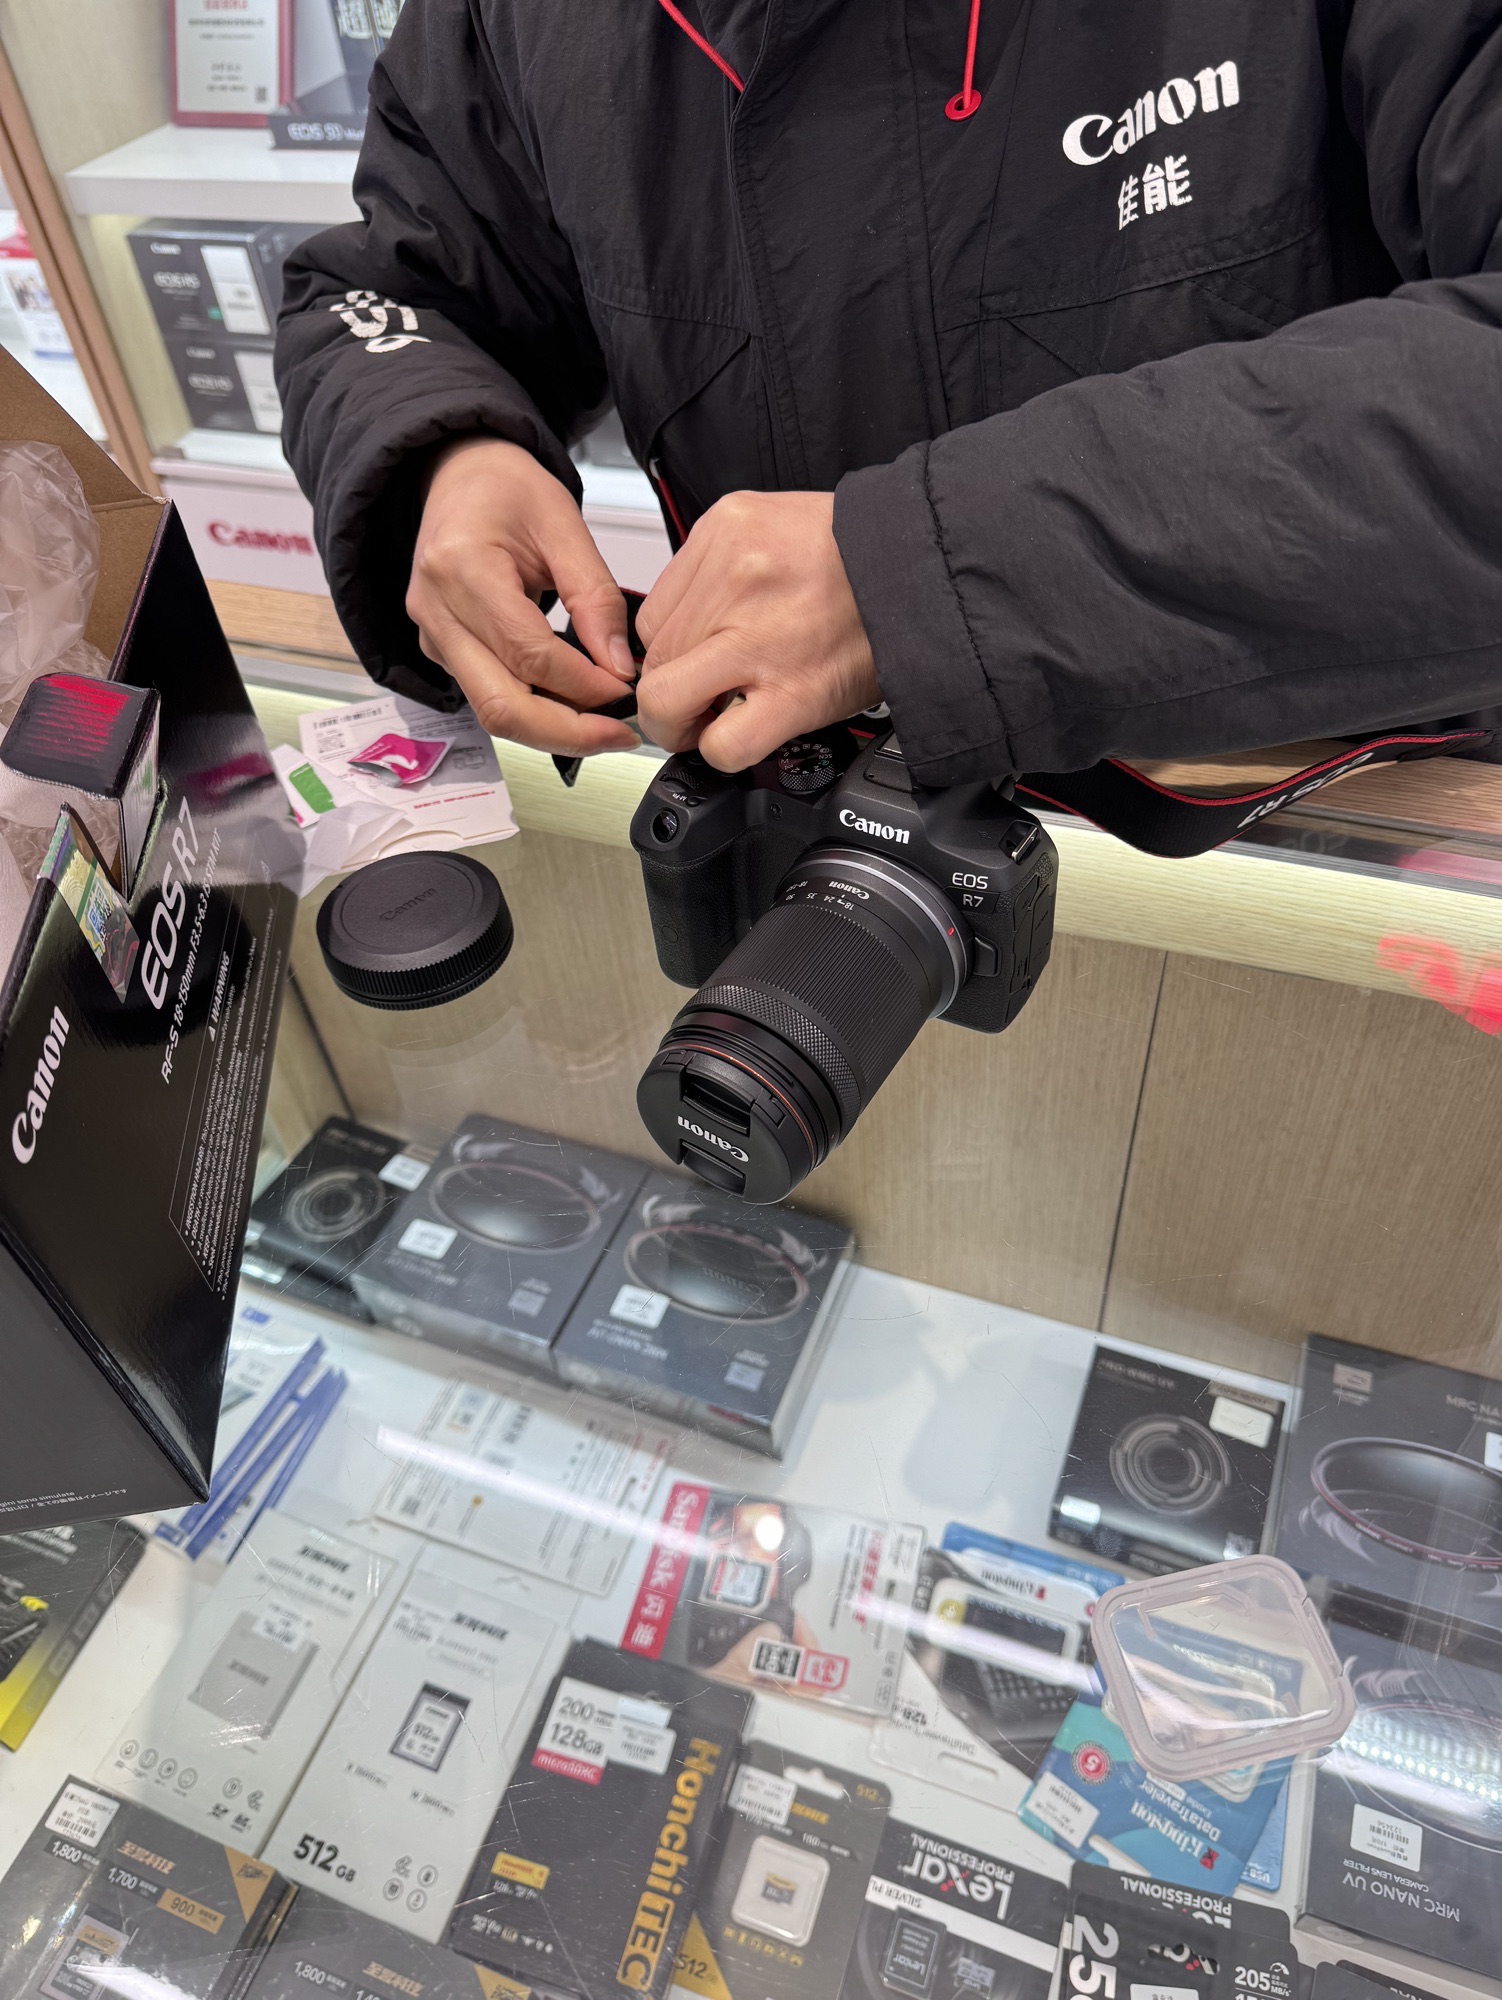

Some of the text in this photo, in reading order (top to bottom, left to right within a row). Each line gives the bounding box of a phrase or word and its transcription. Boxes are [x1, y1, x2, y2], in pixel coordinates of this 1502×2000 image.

[1062, 60, 1240, 166] Canon
[1118, 154, 1193, 231] 佳能
[207, 520, 313, 556] Canon
[838, 809, 911, 845] Canon
[829, 880, 870, 901] Canon
[952, 872, 989, 890] EOS
[140, 796, 201, 1010] EOS R7
[962, 894, 984, 909] R7
[211, 951, 230, 1023] WARNING
[161, 1030, 181, 1085] RF-S
[173, 951, 197, 1027] 18-150mm
[11, 1005, 70, 1165] Canon
[676, 1114, 749, 1164] Canon
[38, 1491, 75, 1502] simulate
[558, 1697, 595, 1722] 200
[1130, 1801, 1205, 1858] Kingston
[1139, 1779, 1221, 1842] DataTraveler
[51, 1841, 82, 1864] 1,800
[293, 1834, 340, 1873] 512
[335, 1865, 357, 1883] GB
[618, 1737, 722, 1982] HonchiTEC
[911, 1832, 1015, 1883] PROFESSIONAL
[108, 1866, 138, 1890] 1,700
[903, 1850, 1012, 1920] Lexar
[1343, 1857, 1430, 1892] CAMERA LENS FILTER
[170, 1896, 195, 1917] 900
[885, 1885, 923, 1909] SILVER
[1120, 1876, 1232, 1916] PROFESSIONAL
[1342, 1872, 1461, 1922] MRC NANO UV
[294, 1961, 326, 1984] 1,800
[893, 1953, 927, 1976] Lexar
[1069, 1913, 1119, 2000] 25
[1234, 1966, 1271, 1991] 205
